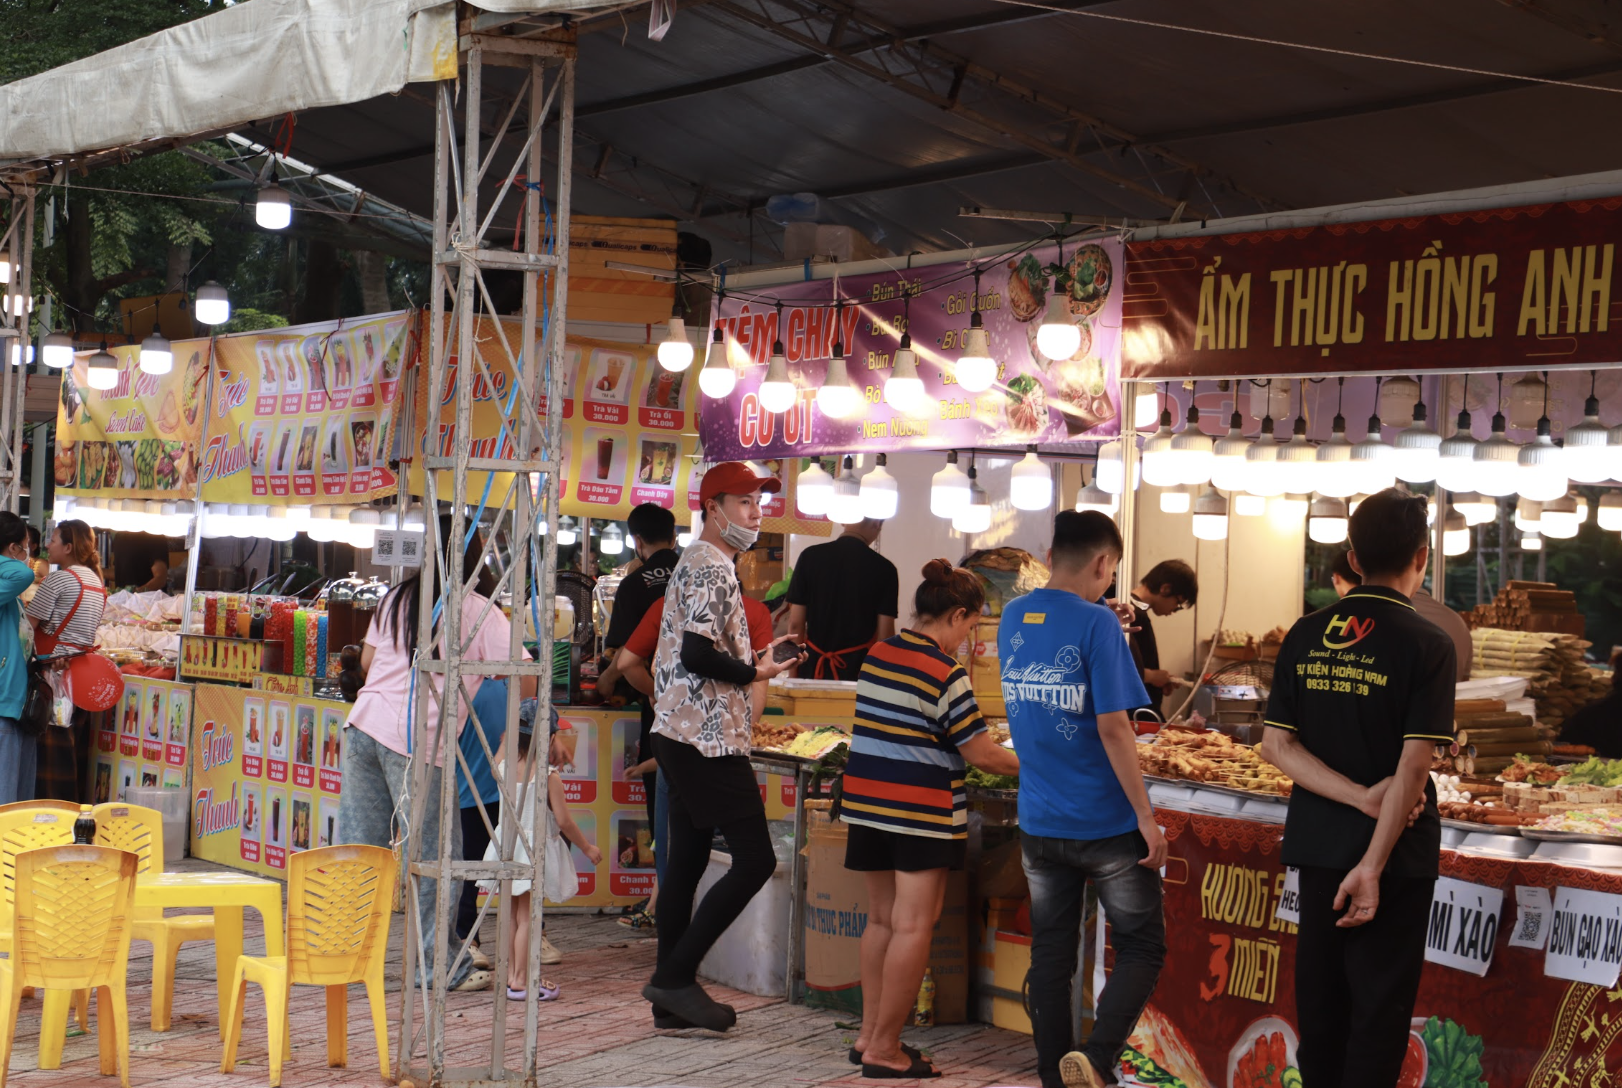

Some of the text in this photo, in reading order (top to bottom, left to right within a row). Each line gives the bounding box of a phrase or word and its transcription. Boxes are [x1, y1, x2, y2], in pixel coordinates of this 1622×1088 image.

[1193, 240, 1615, 357] ẨM THỰC HỒNG ANH
[868, 350, 889, 370] Bún
[593, 413, 619, 421] 30.000
[940, 398, 971, 420] Bánh
[863, 420, 887, 439] Nem
[637, 490, 655, 498] Chanh
[1325, 614, 1372, 639] HN
[1308, 649, 1331, 657] Sound
[1360, 655, 1375, 664] Led
[1306, 678, 1329, 691] 0933
[1331, 680, 1351, 693] 326
[1307, 660, 1329, 677] KIỆN
[1365, 670, 1388, 686] NAM
[1016, 684, 1085, 713] VUITTON
[1201, 862, 1269, 928] HƯƠNG
[1427, 891, 1497, 962] MÌ XÀO
[1549, 899, 1577, 956] BÚN
[1577, 913, 1602, 968] GẠO
[1200, 933, 1280, 1004] 3 MIỀN
